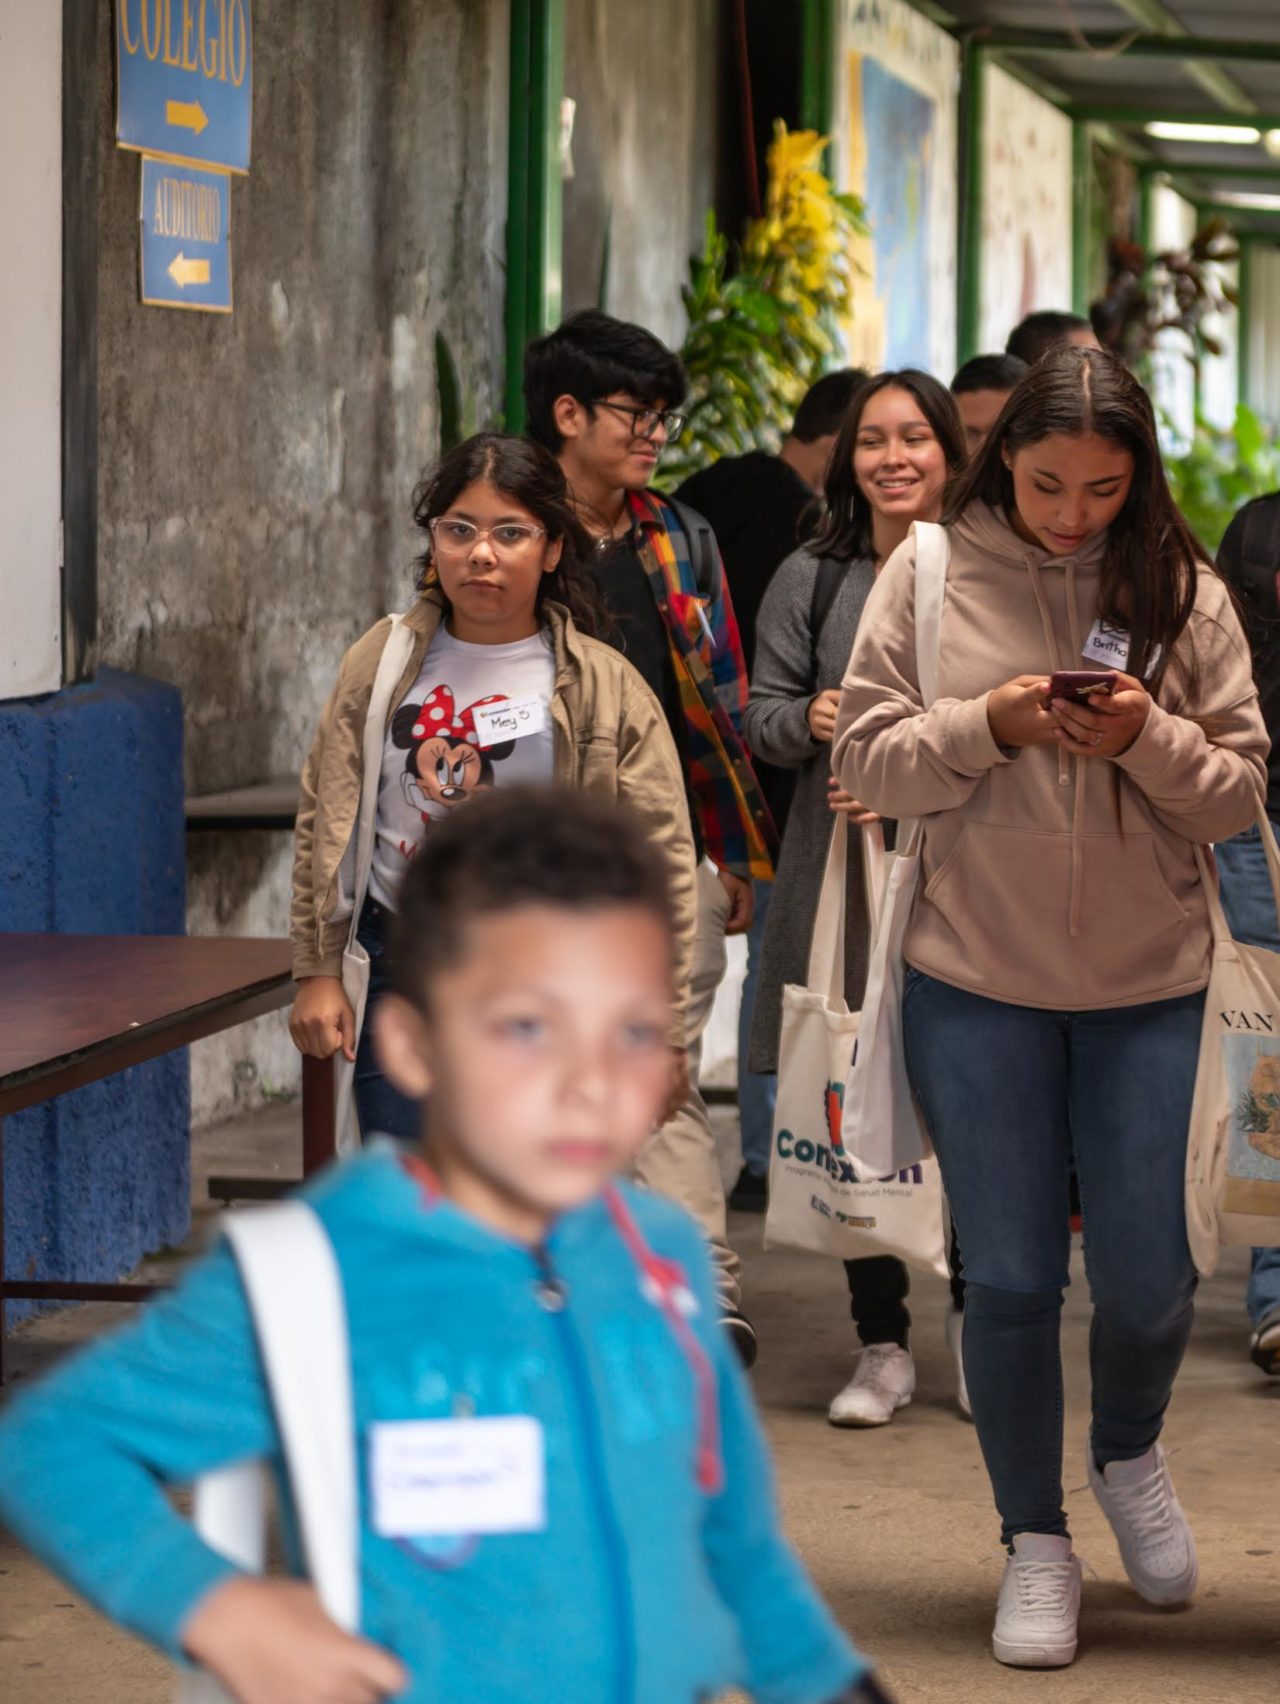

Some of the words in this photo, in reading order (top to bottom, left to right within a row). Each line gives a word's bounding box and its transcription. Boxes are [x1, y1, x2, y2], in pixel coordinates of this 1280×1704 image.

[121, 0, 247, 87] COLEGIO
[154, 178, 221, 244] AUDITORIO
[1220, 1010, 1273, 1031] VAN
[777, 1128, 923, 1184] Conxn
